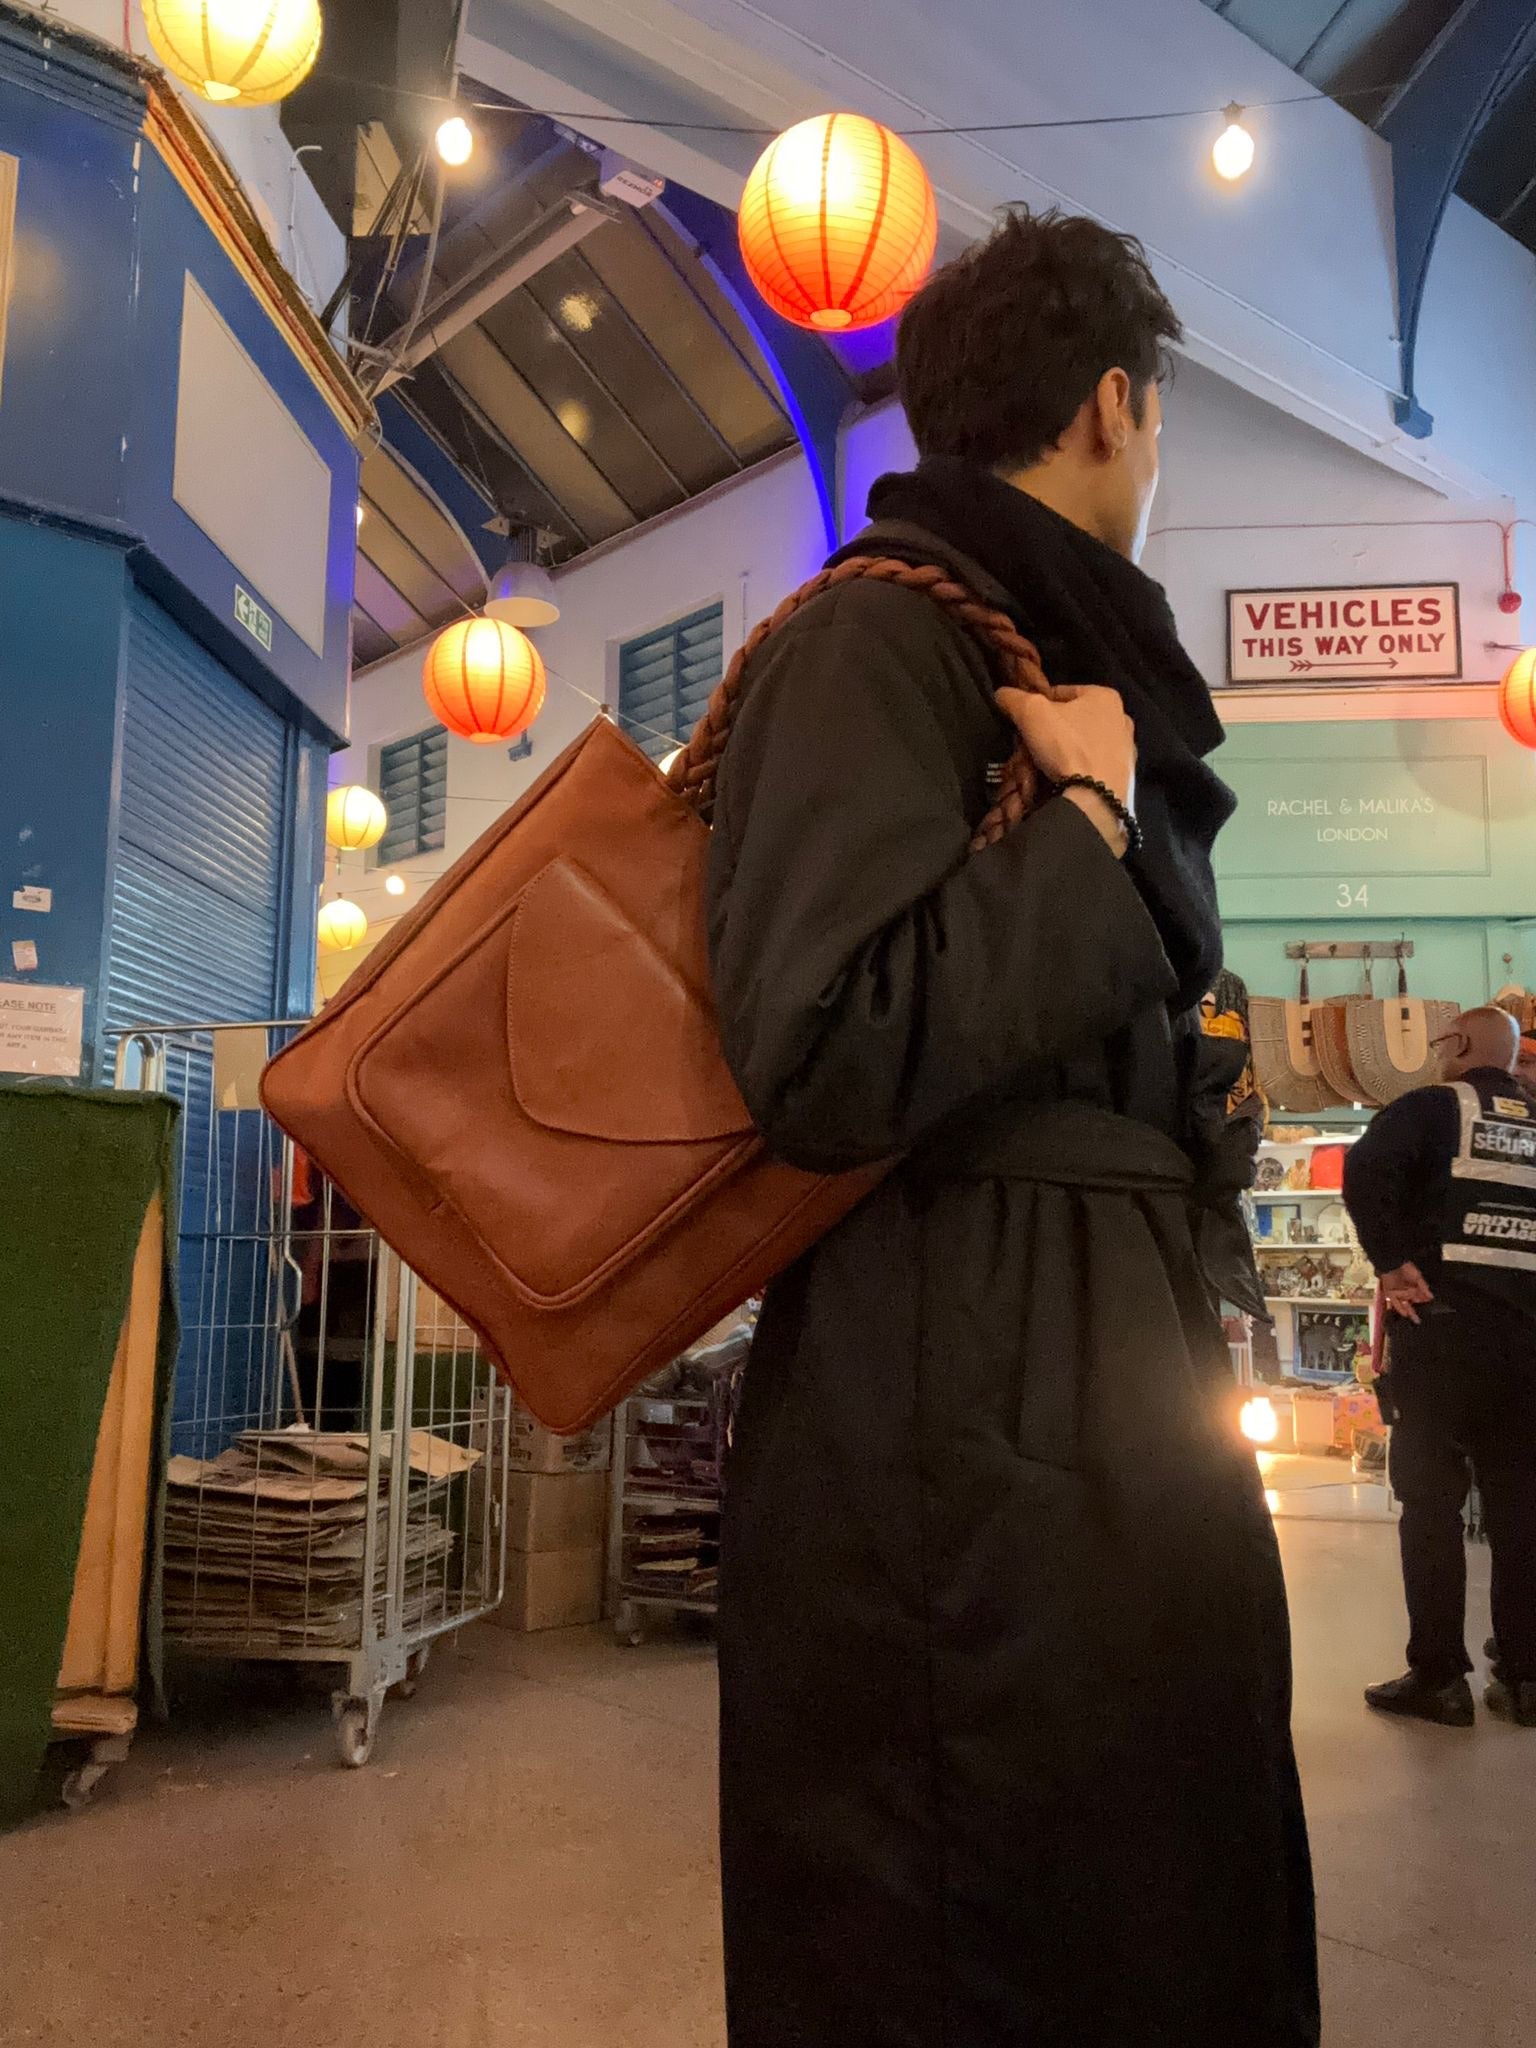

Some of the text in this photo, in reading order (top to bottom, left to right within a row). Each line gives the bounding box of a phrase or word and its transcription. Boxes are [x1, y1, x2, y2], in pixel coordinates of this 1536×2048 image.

[1245, 598, 1441, 630] VEHICLES
[1242, 633, 1446, 657] THIS WAY ONLY
[1267, 797, 1434, 817] RACHEL & MALIKA'S
[1316, 827, 1388, 842] LONDON
[1336, 883, 1369, 908] 34
[28, 1001, 56, 1012] NOTE
[1473, 1132, 1536, 1158] SECURI
